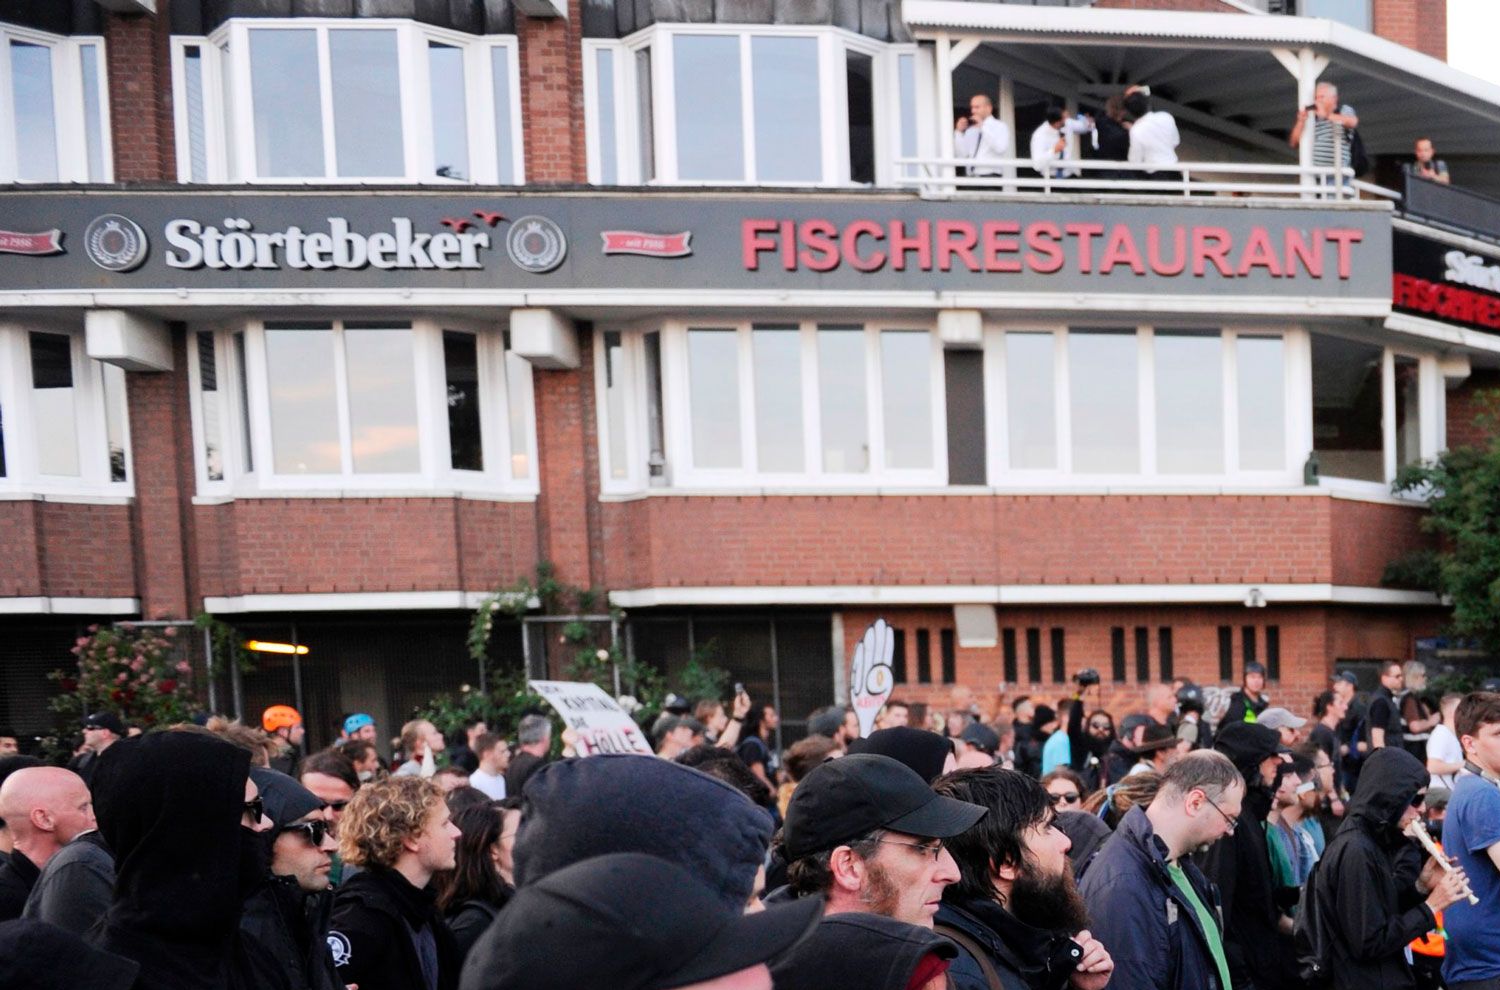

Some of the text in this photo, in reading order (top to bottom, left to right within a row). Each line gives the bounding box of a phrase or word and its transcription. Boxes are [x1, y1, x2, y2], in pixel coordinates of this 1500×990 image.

[164, 217, 489, 269] Störtebeker
[741, 218, 1364, 280] FISCHRESTAURANT
[582, 727, 646, 754] HÖLLE
